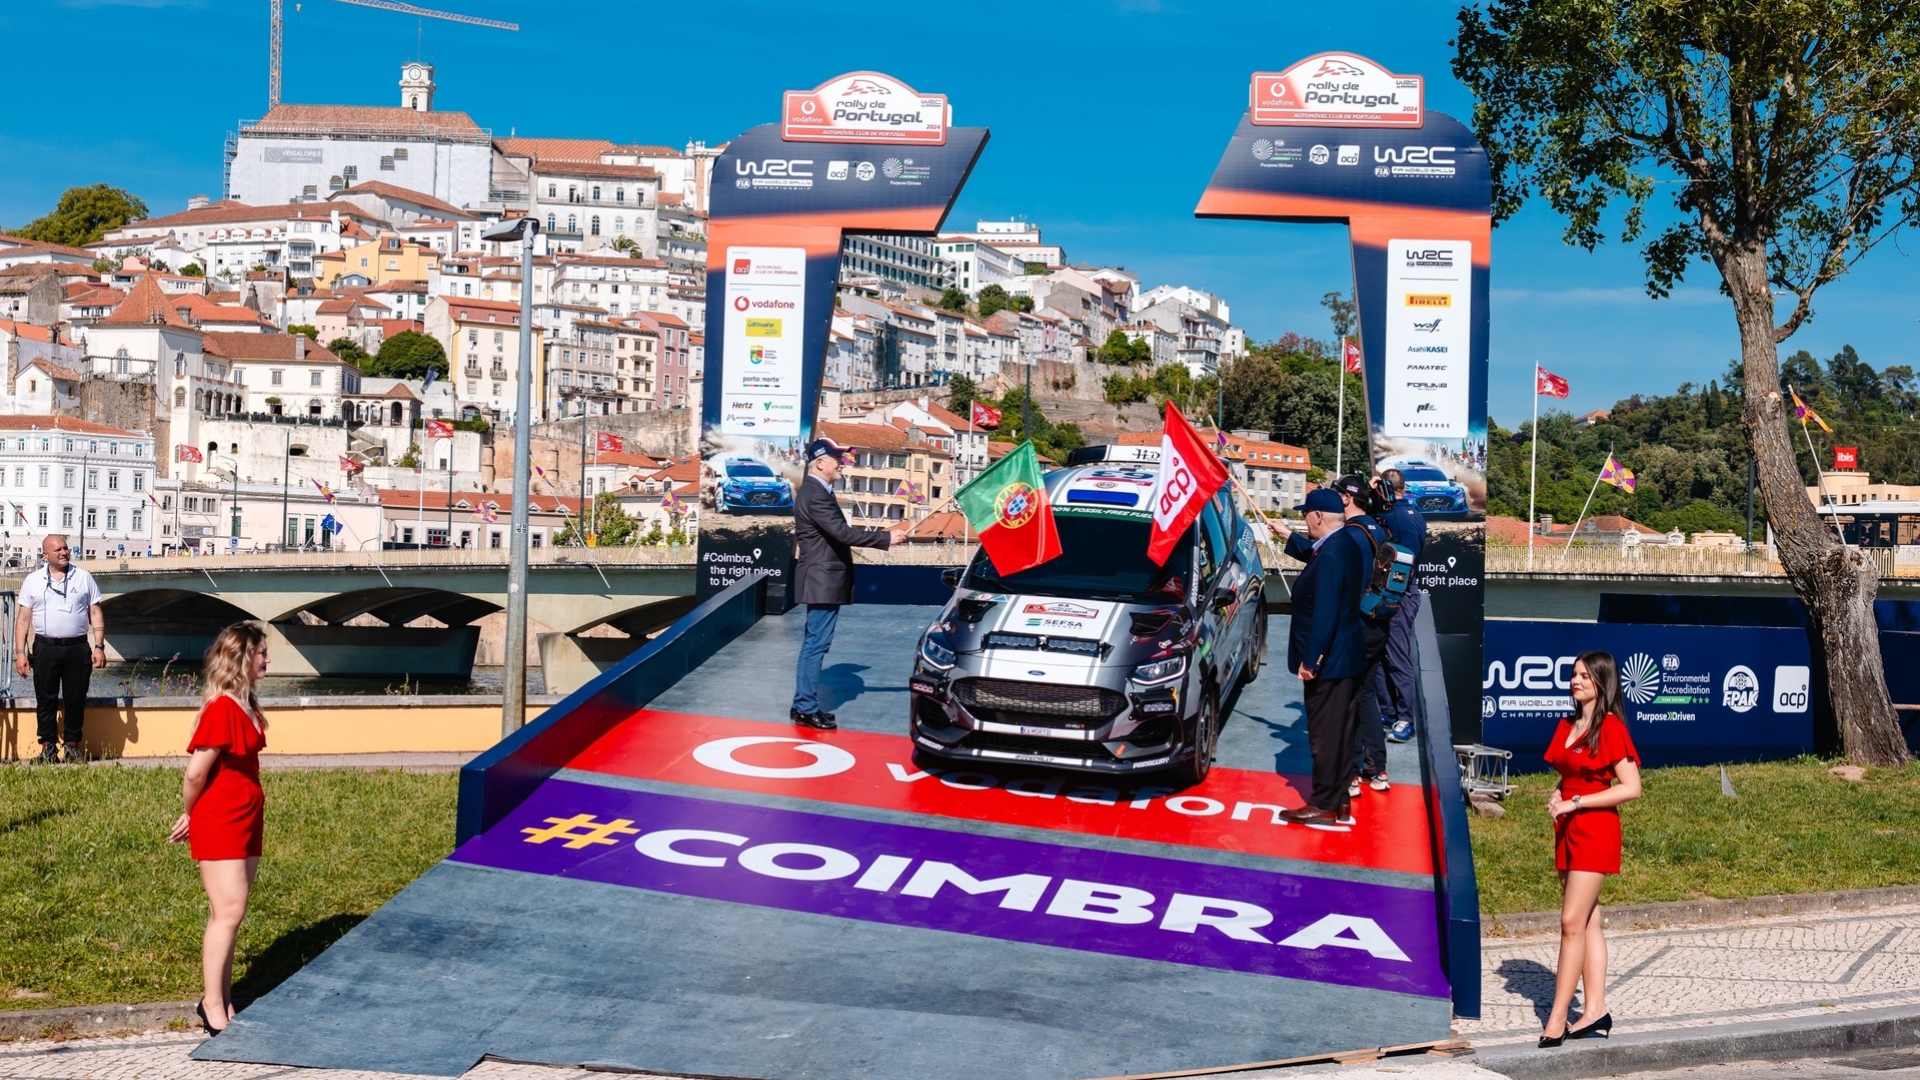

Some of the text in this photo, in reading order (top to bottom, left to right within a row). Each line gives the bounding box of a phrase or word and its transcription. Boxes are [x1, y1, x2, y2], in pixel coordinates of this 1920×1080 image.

[1307, 82, 1360, 92] rally de
[836, 100, 867, 110] rally
[1304, 92, 1399, 107] Portugal
[833, 109, 923, 125] Portugal
[1374, 145, 1455, 164] WRC
[736, 158, 814, 176] WRC
[1406, 250, 1453, 260] WRC
[752, 300, 795, 309] vodafone
[1410, 296, 1447, 305] PIRELLI
[1837, 452, 1854, 462] ibis
[1160, 468, 1190, 515] acp
[1072, 507, 1130, 516] FOSSIL-FREE
[703, 552, 754, 564] #Coimbra,
[710, 565, 781, 577] the right place
[1418, 562, 1448, 573] mbra,
[710, 577, 720, 586] to
[1422, 576, 1446, 587] right
[1448, 576, 1477, 587] place
[1664, 658, 1678, 667] FIA
[1662, 672, 1710, 683] Environmental
[1662, 683, 1710, 694] Accreditation
[1722, 690, 1759, 707] FPAK
[1780, 692, 1806, 709] acp
[1637, 711, 1696, 723] Purpose Driven
[520, 813, 1412, 962] #COIMBRA
